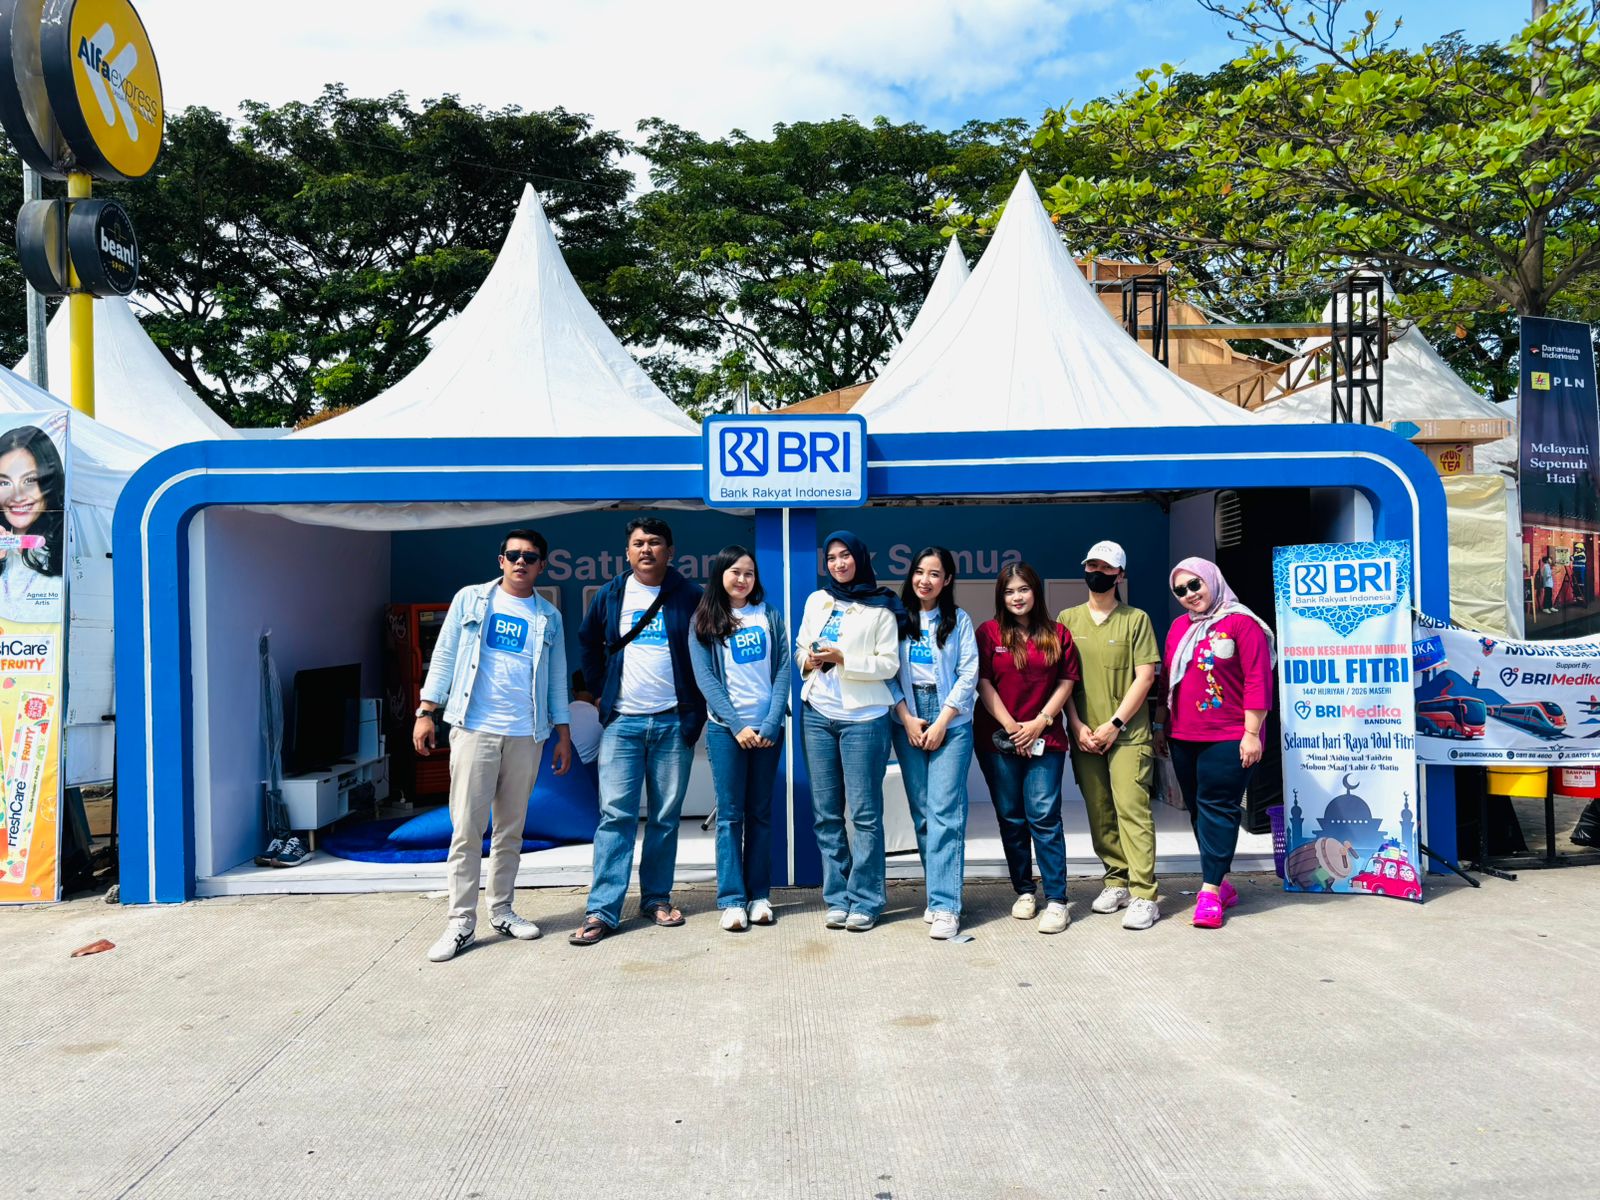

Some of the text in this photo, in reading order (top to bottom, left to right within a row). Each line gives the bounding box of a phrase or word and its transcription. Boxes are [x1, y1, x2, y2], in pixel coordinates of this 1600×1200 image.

[1541, 344, 1581, 355] Danantara
[1541, 352, 1579, 361] Indonesia
[778, 431, 850, 473] BRI
[1440, 450, 1461, 462] FRUIT
[1531, 443, 1589, 456] Melayani
[1441, 461, 1460, 472] TEA
[1530, 458, 1588, 470] Sepenuh
[1546, 473, 1576, 484] Hati
[720, 487, 852, 500] Bank Rakyat Indonesia
[1334, 561, 1392, 593] BRI
[1295, 594, 1391, 604] Bank Rakyat Indonesia
[495, 619, 522, 638] BRI
[496, 634, 519, 647] mo
[735, 631, 761, 648] BRI
[741, 645, 762, 657] mo
[1284, 643, 1408, 656] POSKO KESEHATAN MUDIK
[1, 658, 46, 671] FRUITY
[1284, 657, 1409, 684] IDUL FITRI
[1346, 687, 1350, 695] /
[1351, 687, 1368, 695] 2026
[1369, 687, 1392, 695] MASEHI
[1315, 704, 1402, 718] BRIMedika
[21, 727, 36, 761] FRUITY
[1284, 731, 1415, 753] Selamat hari Raya Idul Fitri
[8, 781, 27, 847] FreshCare
